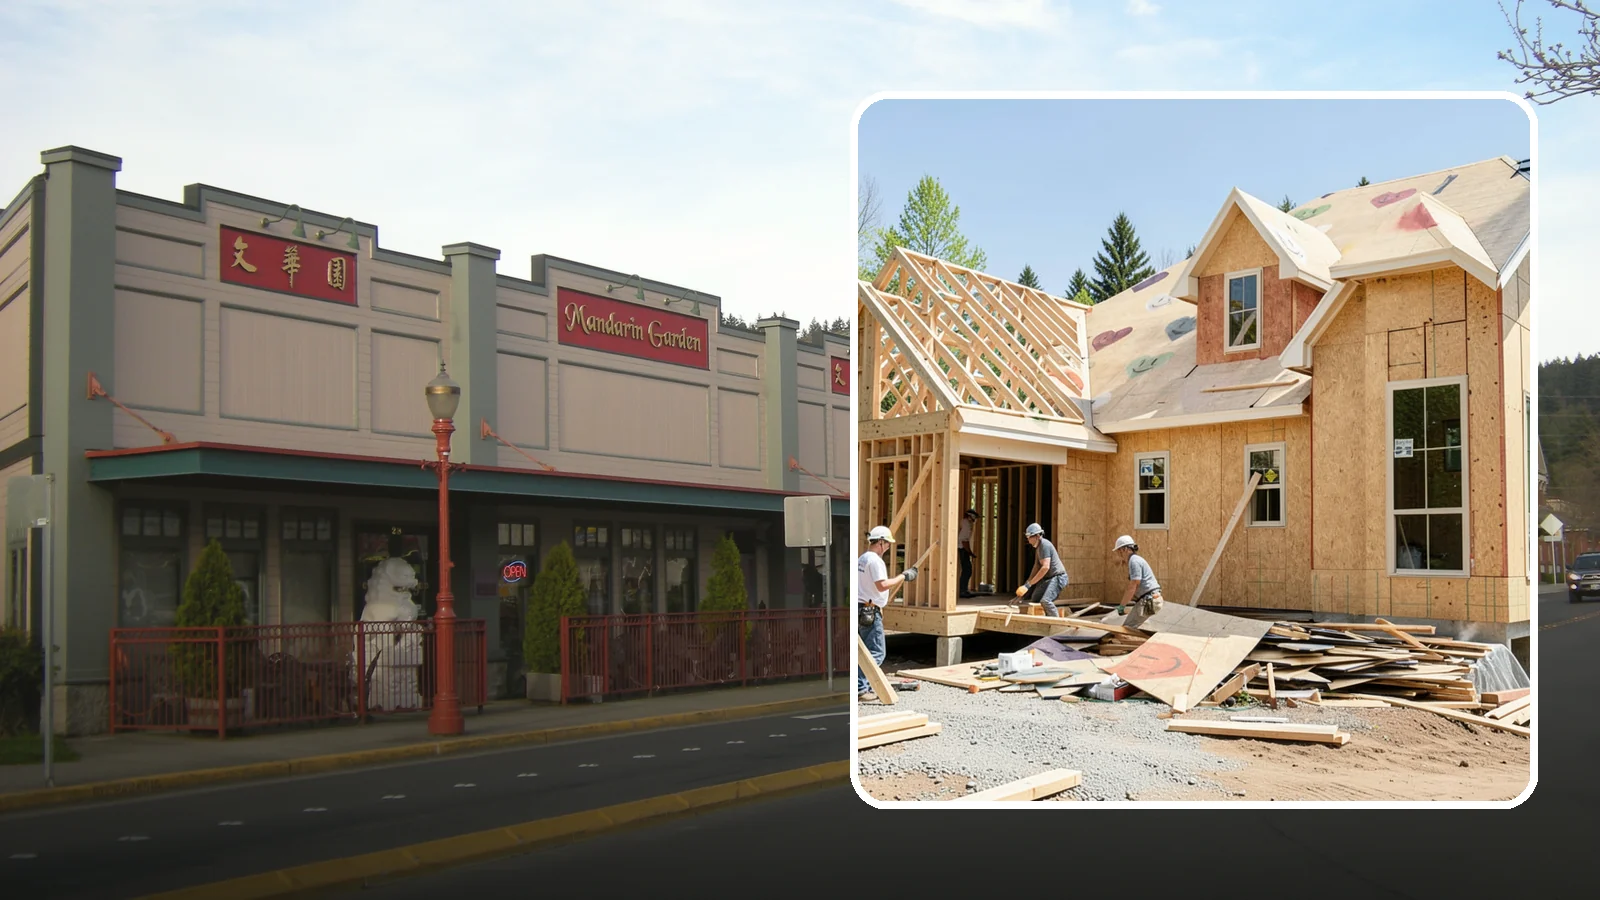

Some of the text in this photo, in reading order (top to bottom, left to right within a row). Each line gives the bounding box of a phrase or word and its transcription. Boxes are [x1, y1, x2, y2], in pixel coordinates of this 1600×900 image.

[564, 302, 702, 352] Mandarin Garden
[503, 565, 527, 578] OPEN
